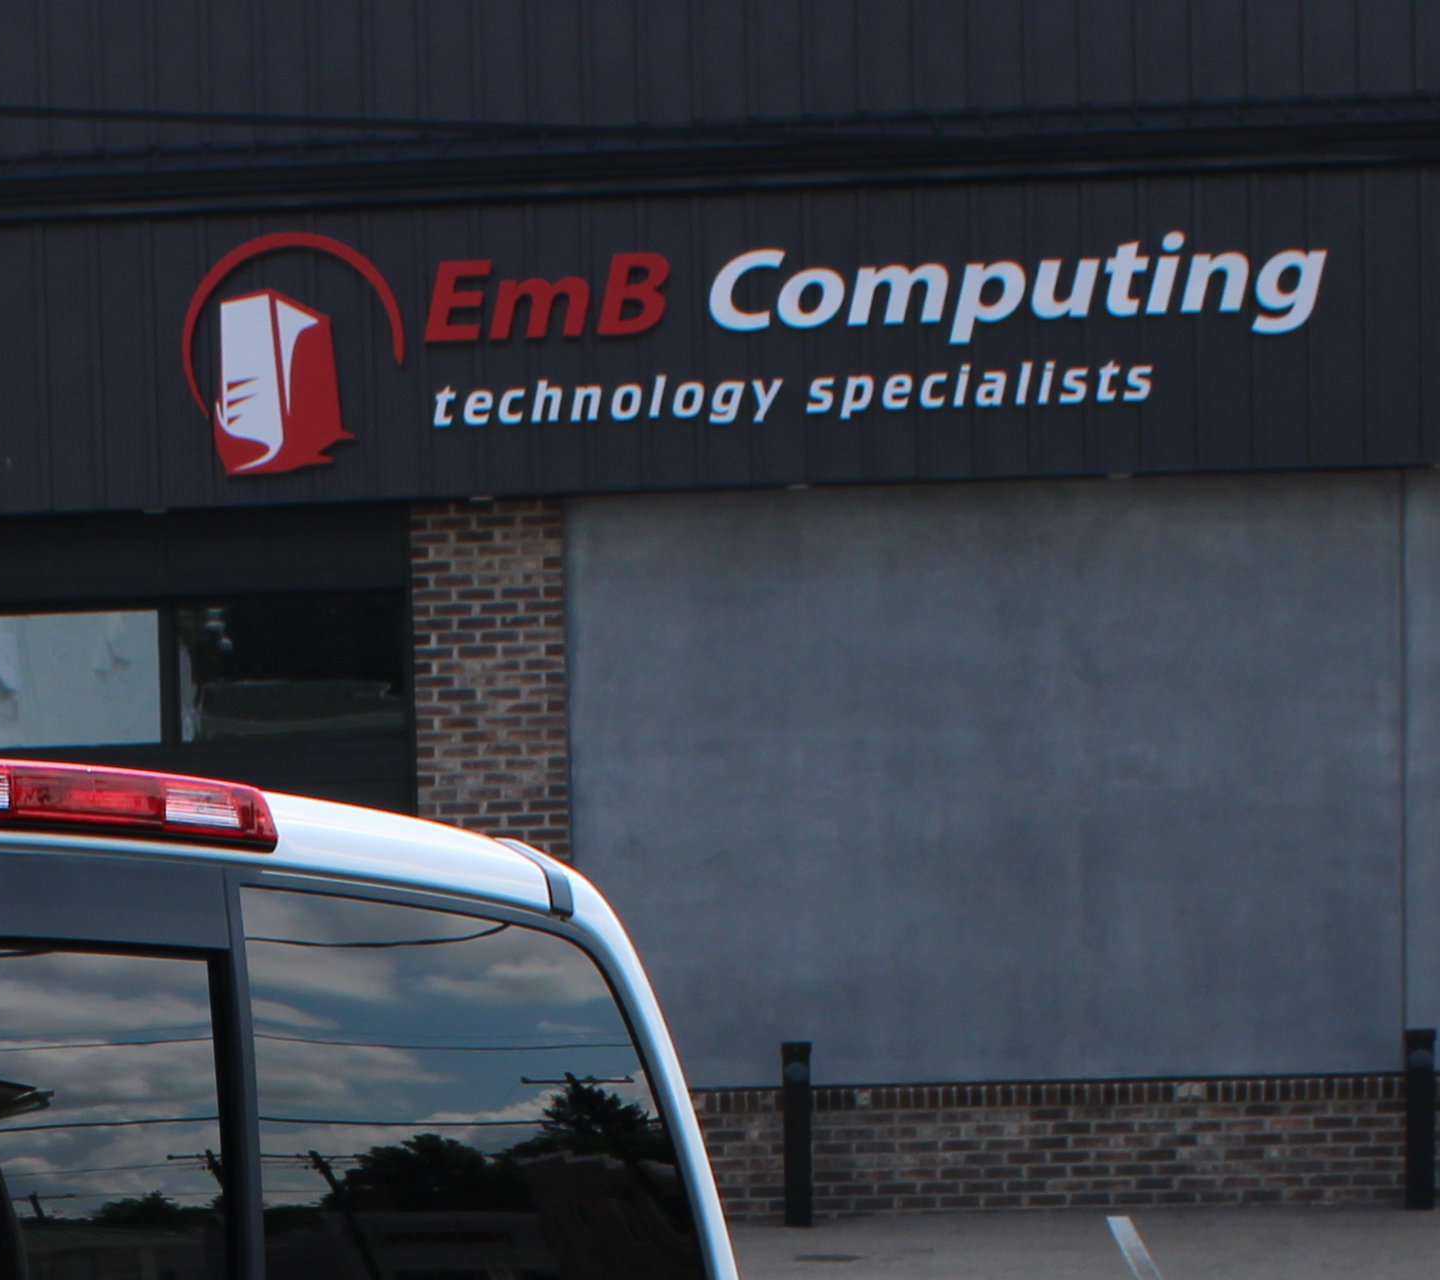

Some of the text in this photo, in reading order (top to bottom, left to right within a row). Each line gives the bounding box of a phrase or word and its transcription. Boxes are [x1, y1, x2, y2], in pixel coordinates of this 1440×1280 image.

[423, 231, 1328, 344] EmB Computing
[431, 359, 1156, 428] technology specialists
